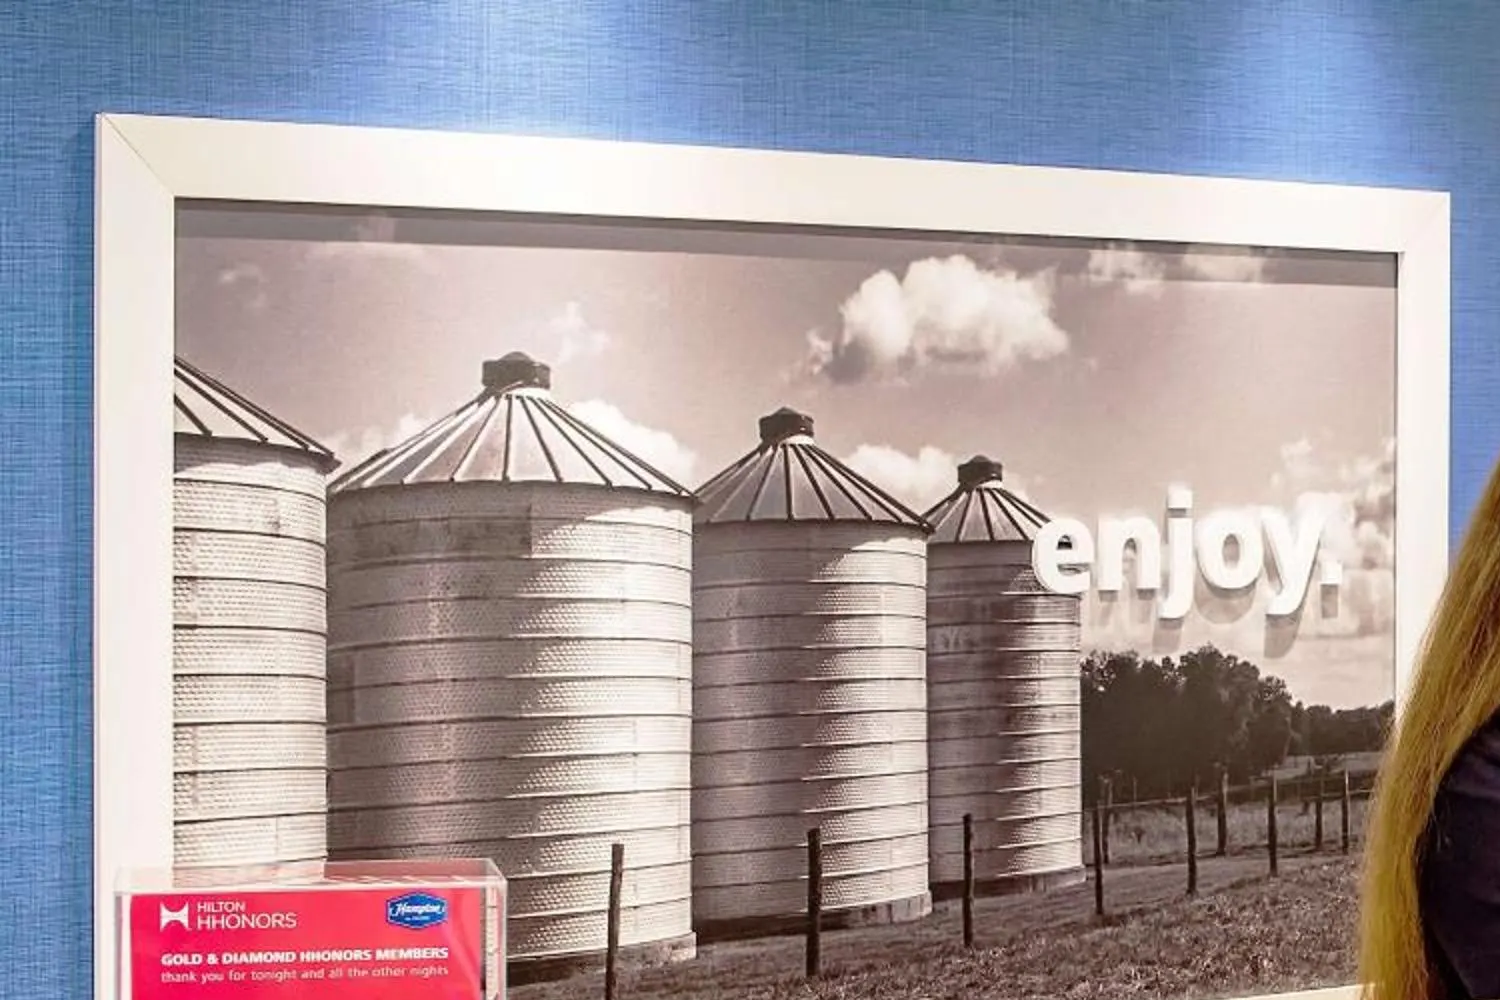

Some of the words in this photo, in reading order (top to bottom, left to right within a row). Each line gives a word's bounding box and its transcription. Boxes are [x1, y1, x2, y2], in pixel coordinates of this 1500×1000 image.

[197, 901, 246, 913] HILTON
[197, 912, 298, 931] HHONORS
[161, 953, 203, 966] GOLD
[207, 953, 219, 965] &
[222, 951, 296, 964] DIAMOND
[300, 949, 372, 962] HHONORS
[375, 947, 449, 960] MEMBERS
[161, 971, 196, 983] thank
[201, 973, 224, 985] you
[228, 970, 246, 981] for
[251, 968, 298, 983] tonight
[301, 968, 324, 980] and
[328, 967, 343, 979] all
[347, 966, 369, 978] the
[371, 965, 406, 978] other
[410, 965, 449, 979] nights
